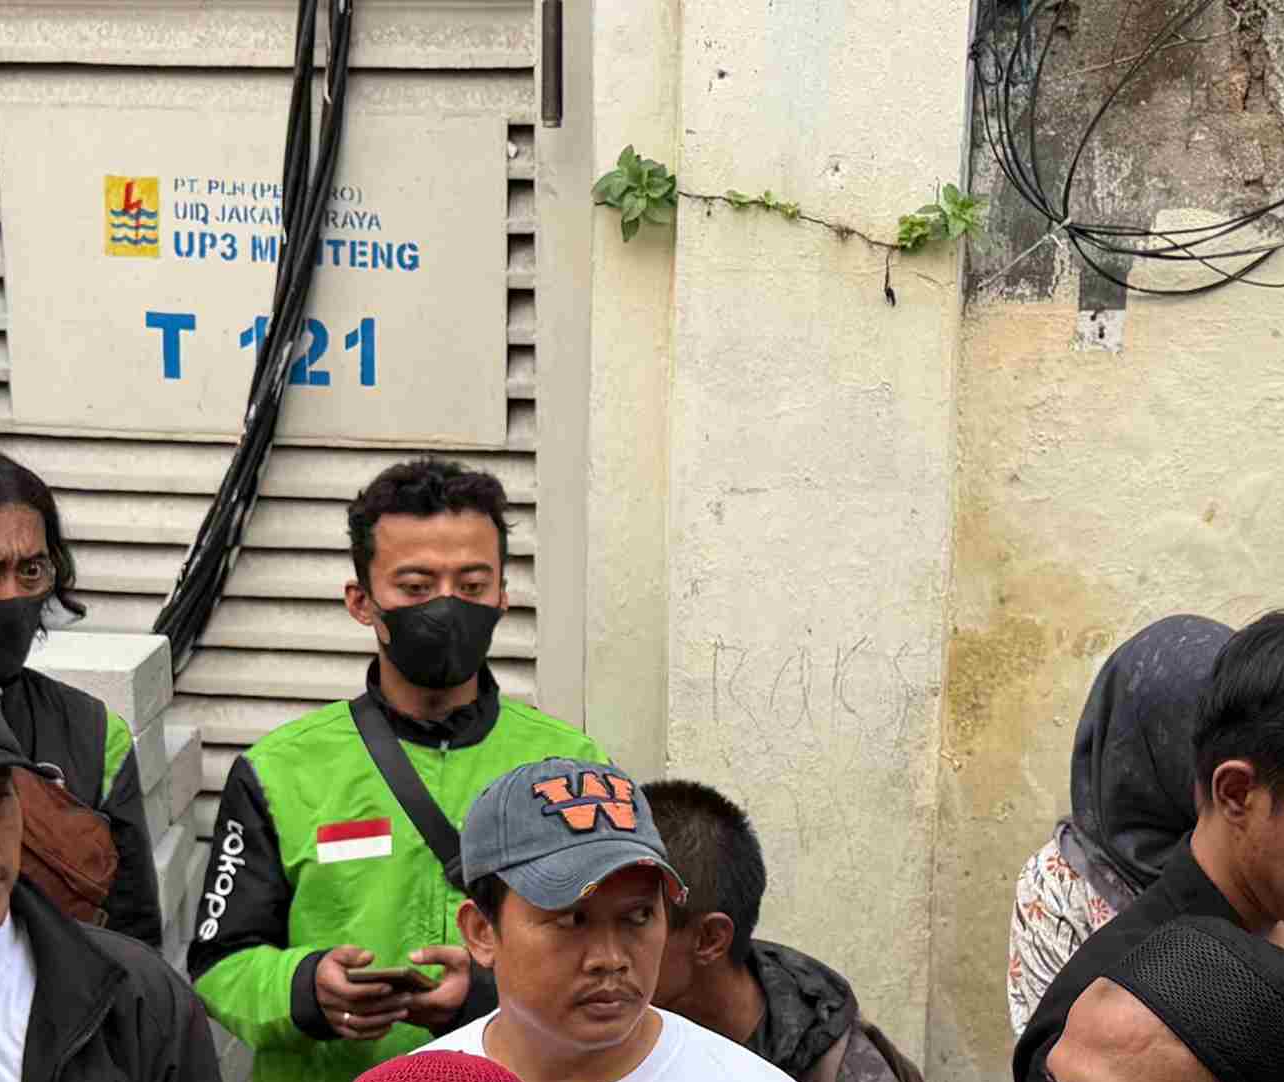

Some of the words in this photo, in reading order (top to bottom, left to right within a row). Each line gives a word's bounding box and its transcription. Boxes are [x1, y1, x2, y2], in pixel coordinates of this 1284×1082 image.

[207, 179, 246, 198] PLN
[174, 201, 208, 225] UID
[325, 210, 382, 231] RAYA
[173, 230, 239, 262] UP3
[250, 234, 421, 272] MTENG
[145, 311, 196, 380] T
[239, 315, 376, 387] 121
[532, 771, 638, 833] W
